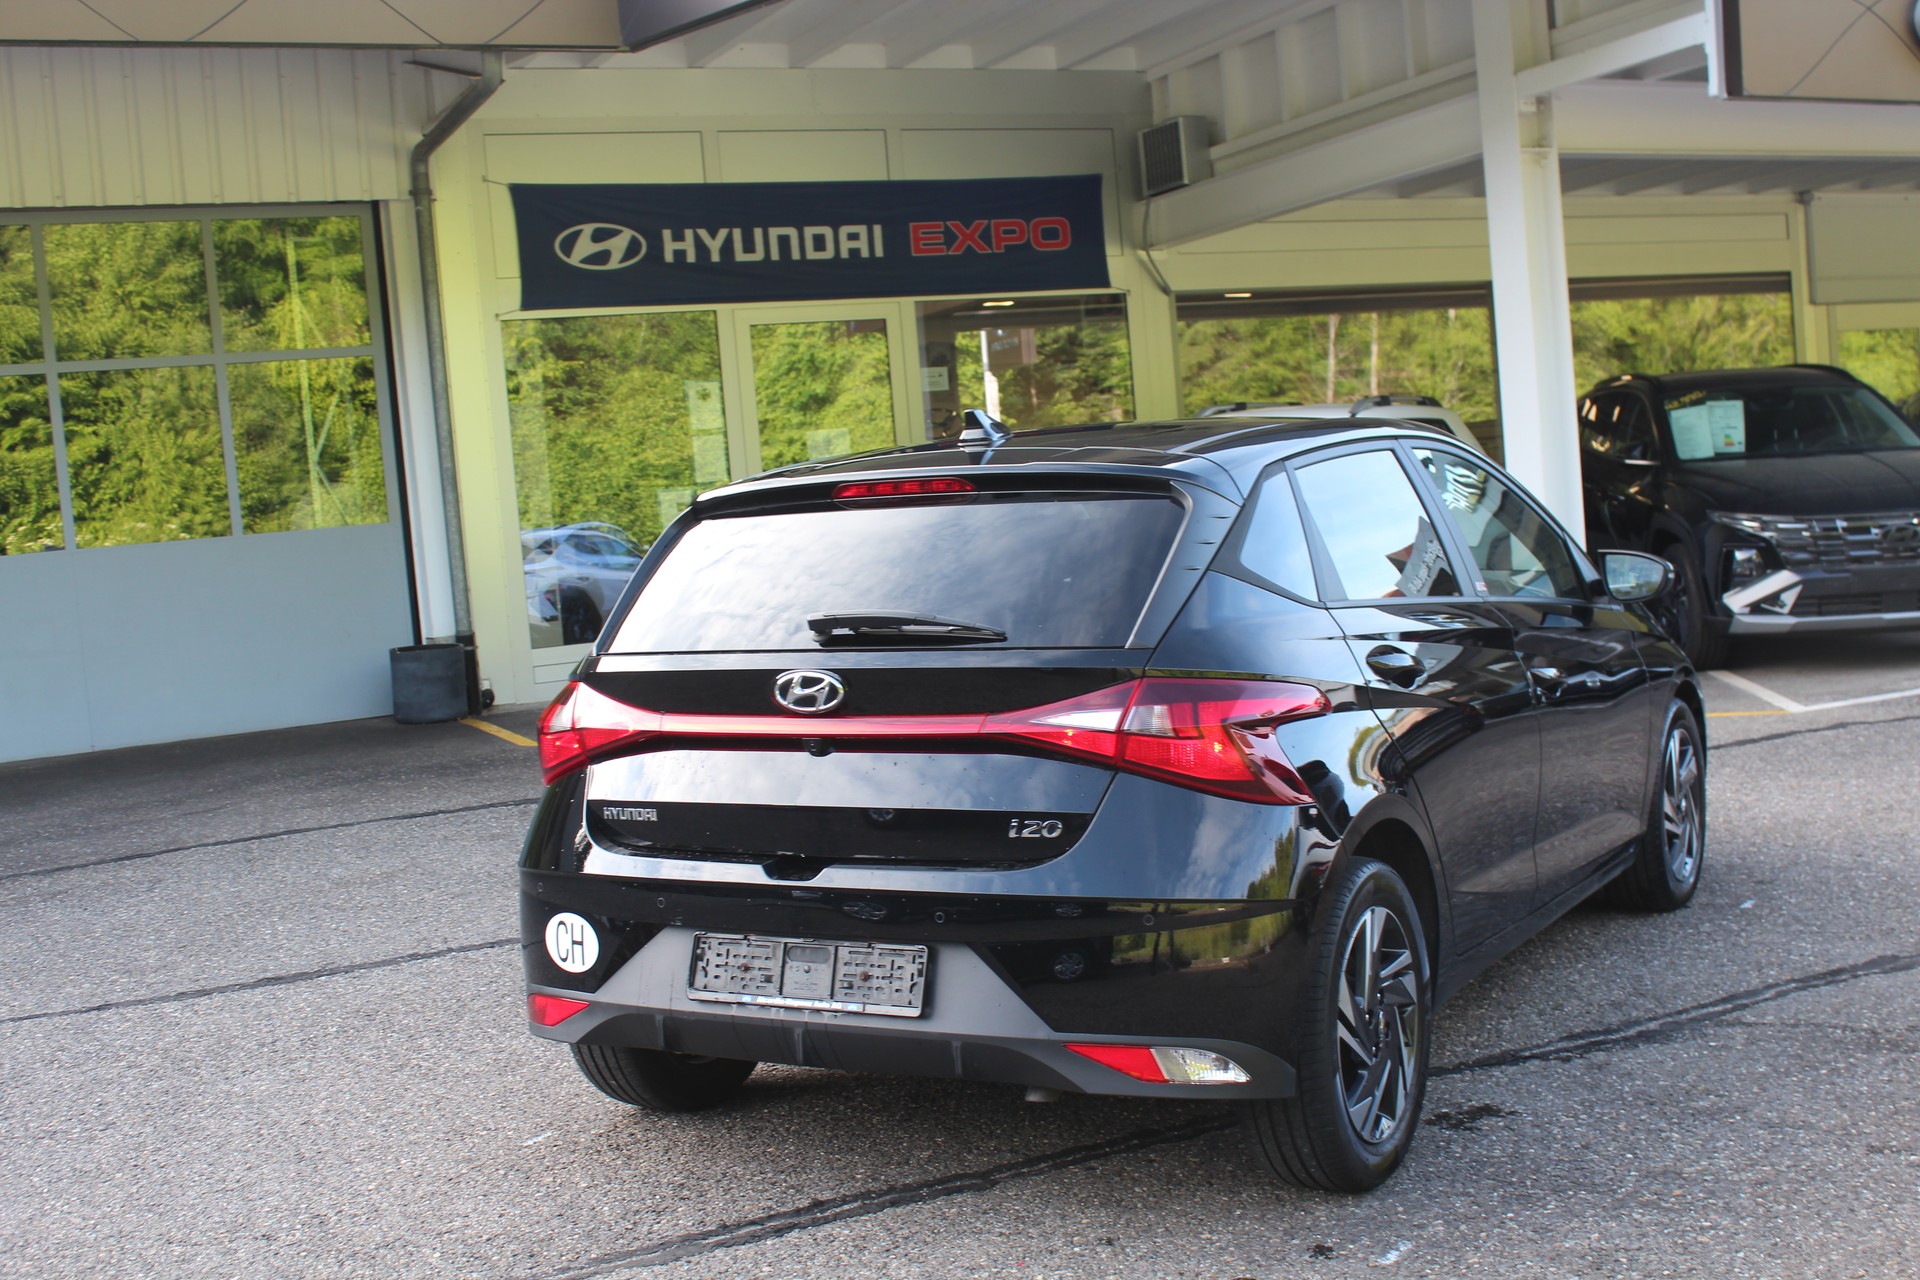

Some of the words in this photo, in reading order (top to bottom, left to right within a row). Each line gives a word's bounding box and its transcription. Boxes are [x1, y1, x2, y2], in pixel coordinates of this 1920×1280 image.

[662, 224, 885, 263] HYUNDAI
[909, 217, 1072, 257] EXPO
[602, 806, 658, 821] HYUNDAI
[1008, 819, 1063, 839] i20
[556, 920, 585, 967] CH
